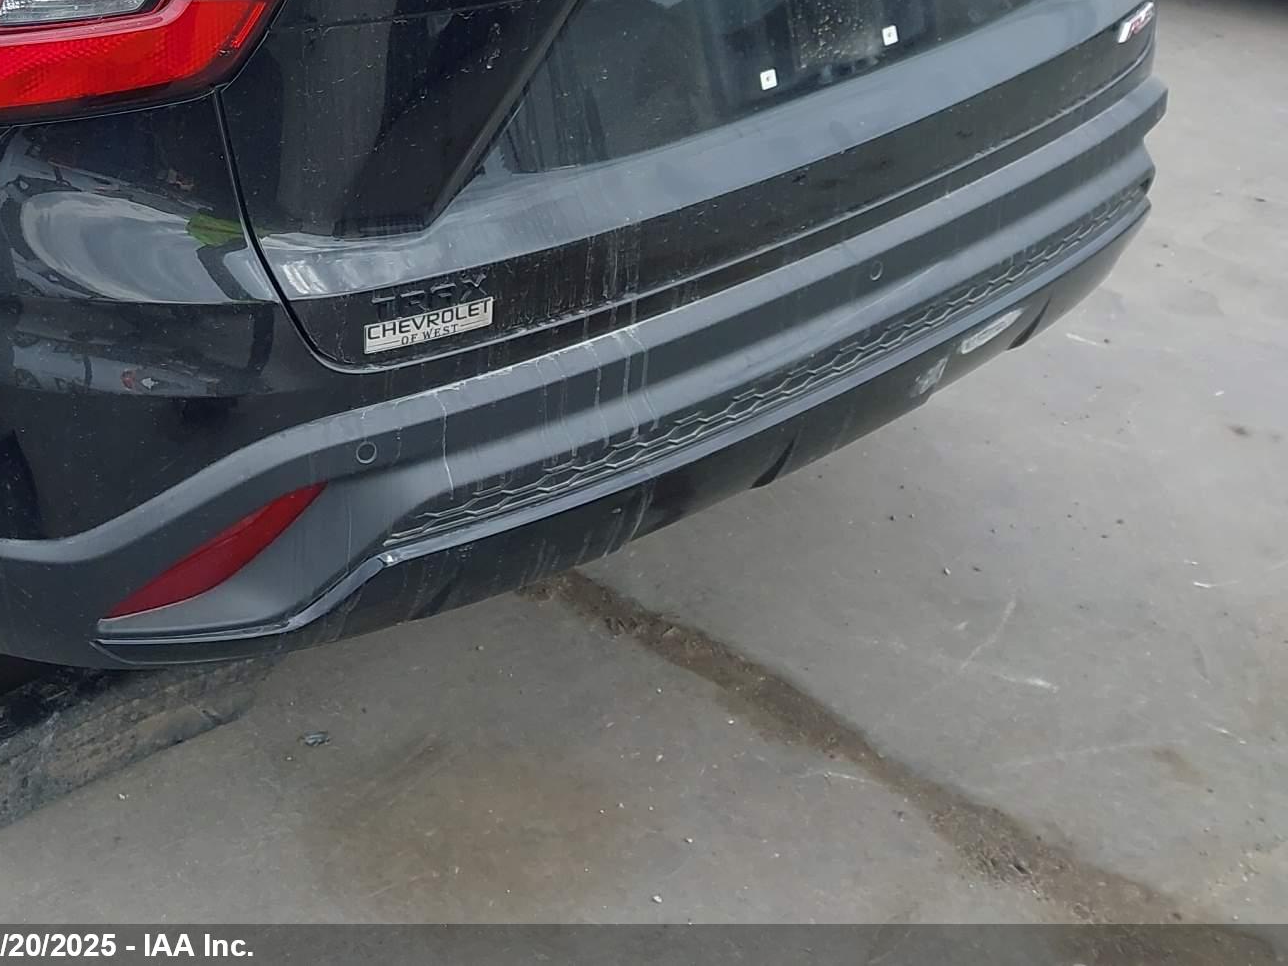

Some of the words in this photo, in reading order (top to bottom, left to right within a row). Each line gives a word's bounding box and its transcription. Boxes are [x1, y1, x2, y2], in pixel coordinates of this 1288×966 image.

[368, 300, 490, 340] CHEVROLET
[401, 335, 417, 346] OF
[423, 324, 459, 341] WEST
